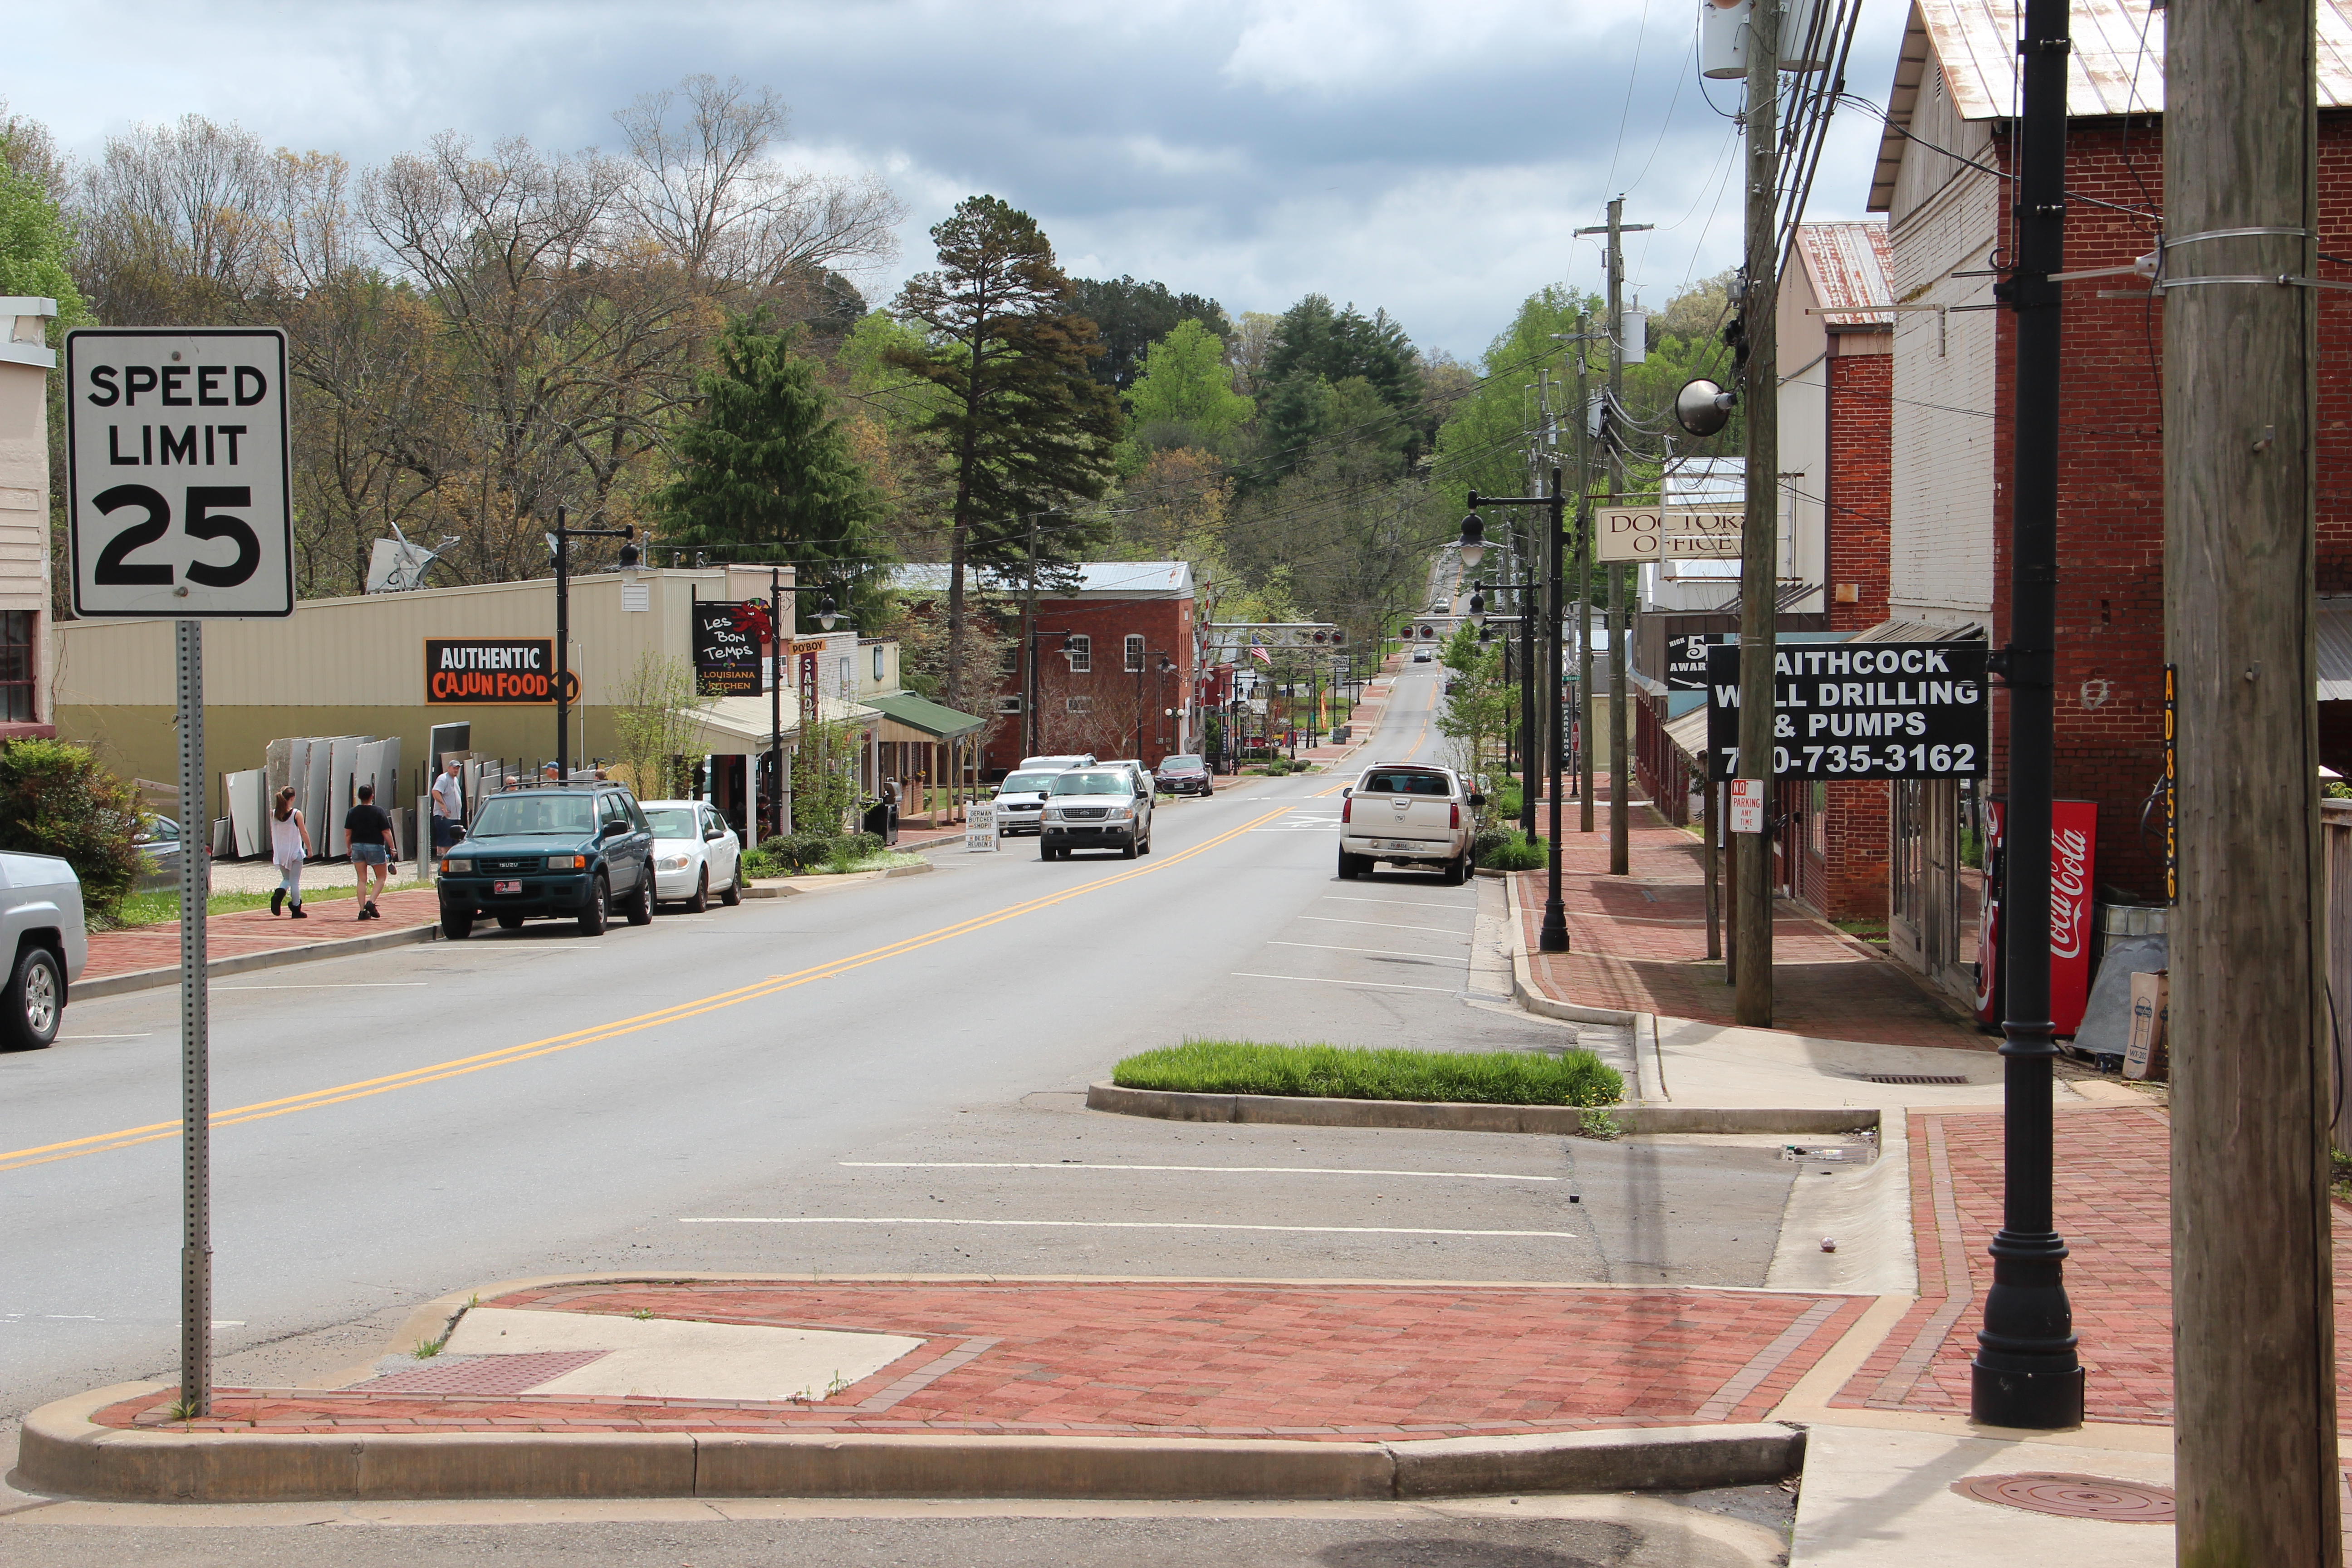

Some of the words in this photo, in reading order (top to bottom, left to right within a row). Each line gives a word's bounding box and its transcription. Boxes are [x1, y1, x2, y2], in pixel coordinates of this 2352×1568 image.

[88, 365, 267, 407] SPEED
[109, 425, 247, 466] LIMIT
[1610, 512, 1744, 533] DOCTOR
[92, 484, 261, 588] 25
[441, 647, 540, 669] AUTHENTIC
[793, 641, 823, 653] PO'BOY
[1669, 637, 1685, 647] HIGH
[1686, 635, 1707, 659] 5
[1670, 662, 1707, 671] AWAR
[1774, 649, 1950, 675] AITHCOCK
[432, 672, 493, 698] CAJUN
[497, 673, 548, 697] FOOD
[1715, 684, 1807, 708] WLL
[1819, 680, 1978, 706] DRILLING
[1774, 714, 1796, 738] &
[1809, 712, 1926, 737] PUMPS
[1721, 744, 1975, 774] 70-735-3162
[1733, 782, 1745, 794] NO
[2165, 670, 2175, 898] AD8556
[1733, 798, 1760, 808] PARKING
[1740, 818, 1753, 826] TIME
[2130, 1049, 2147, 1059] WX-202
